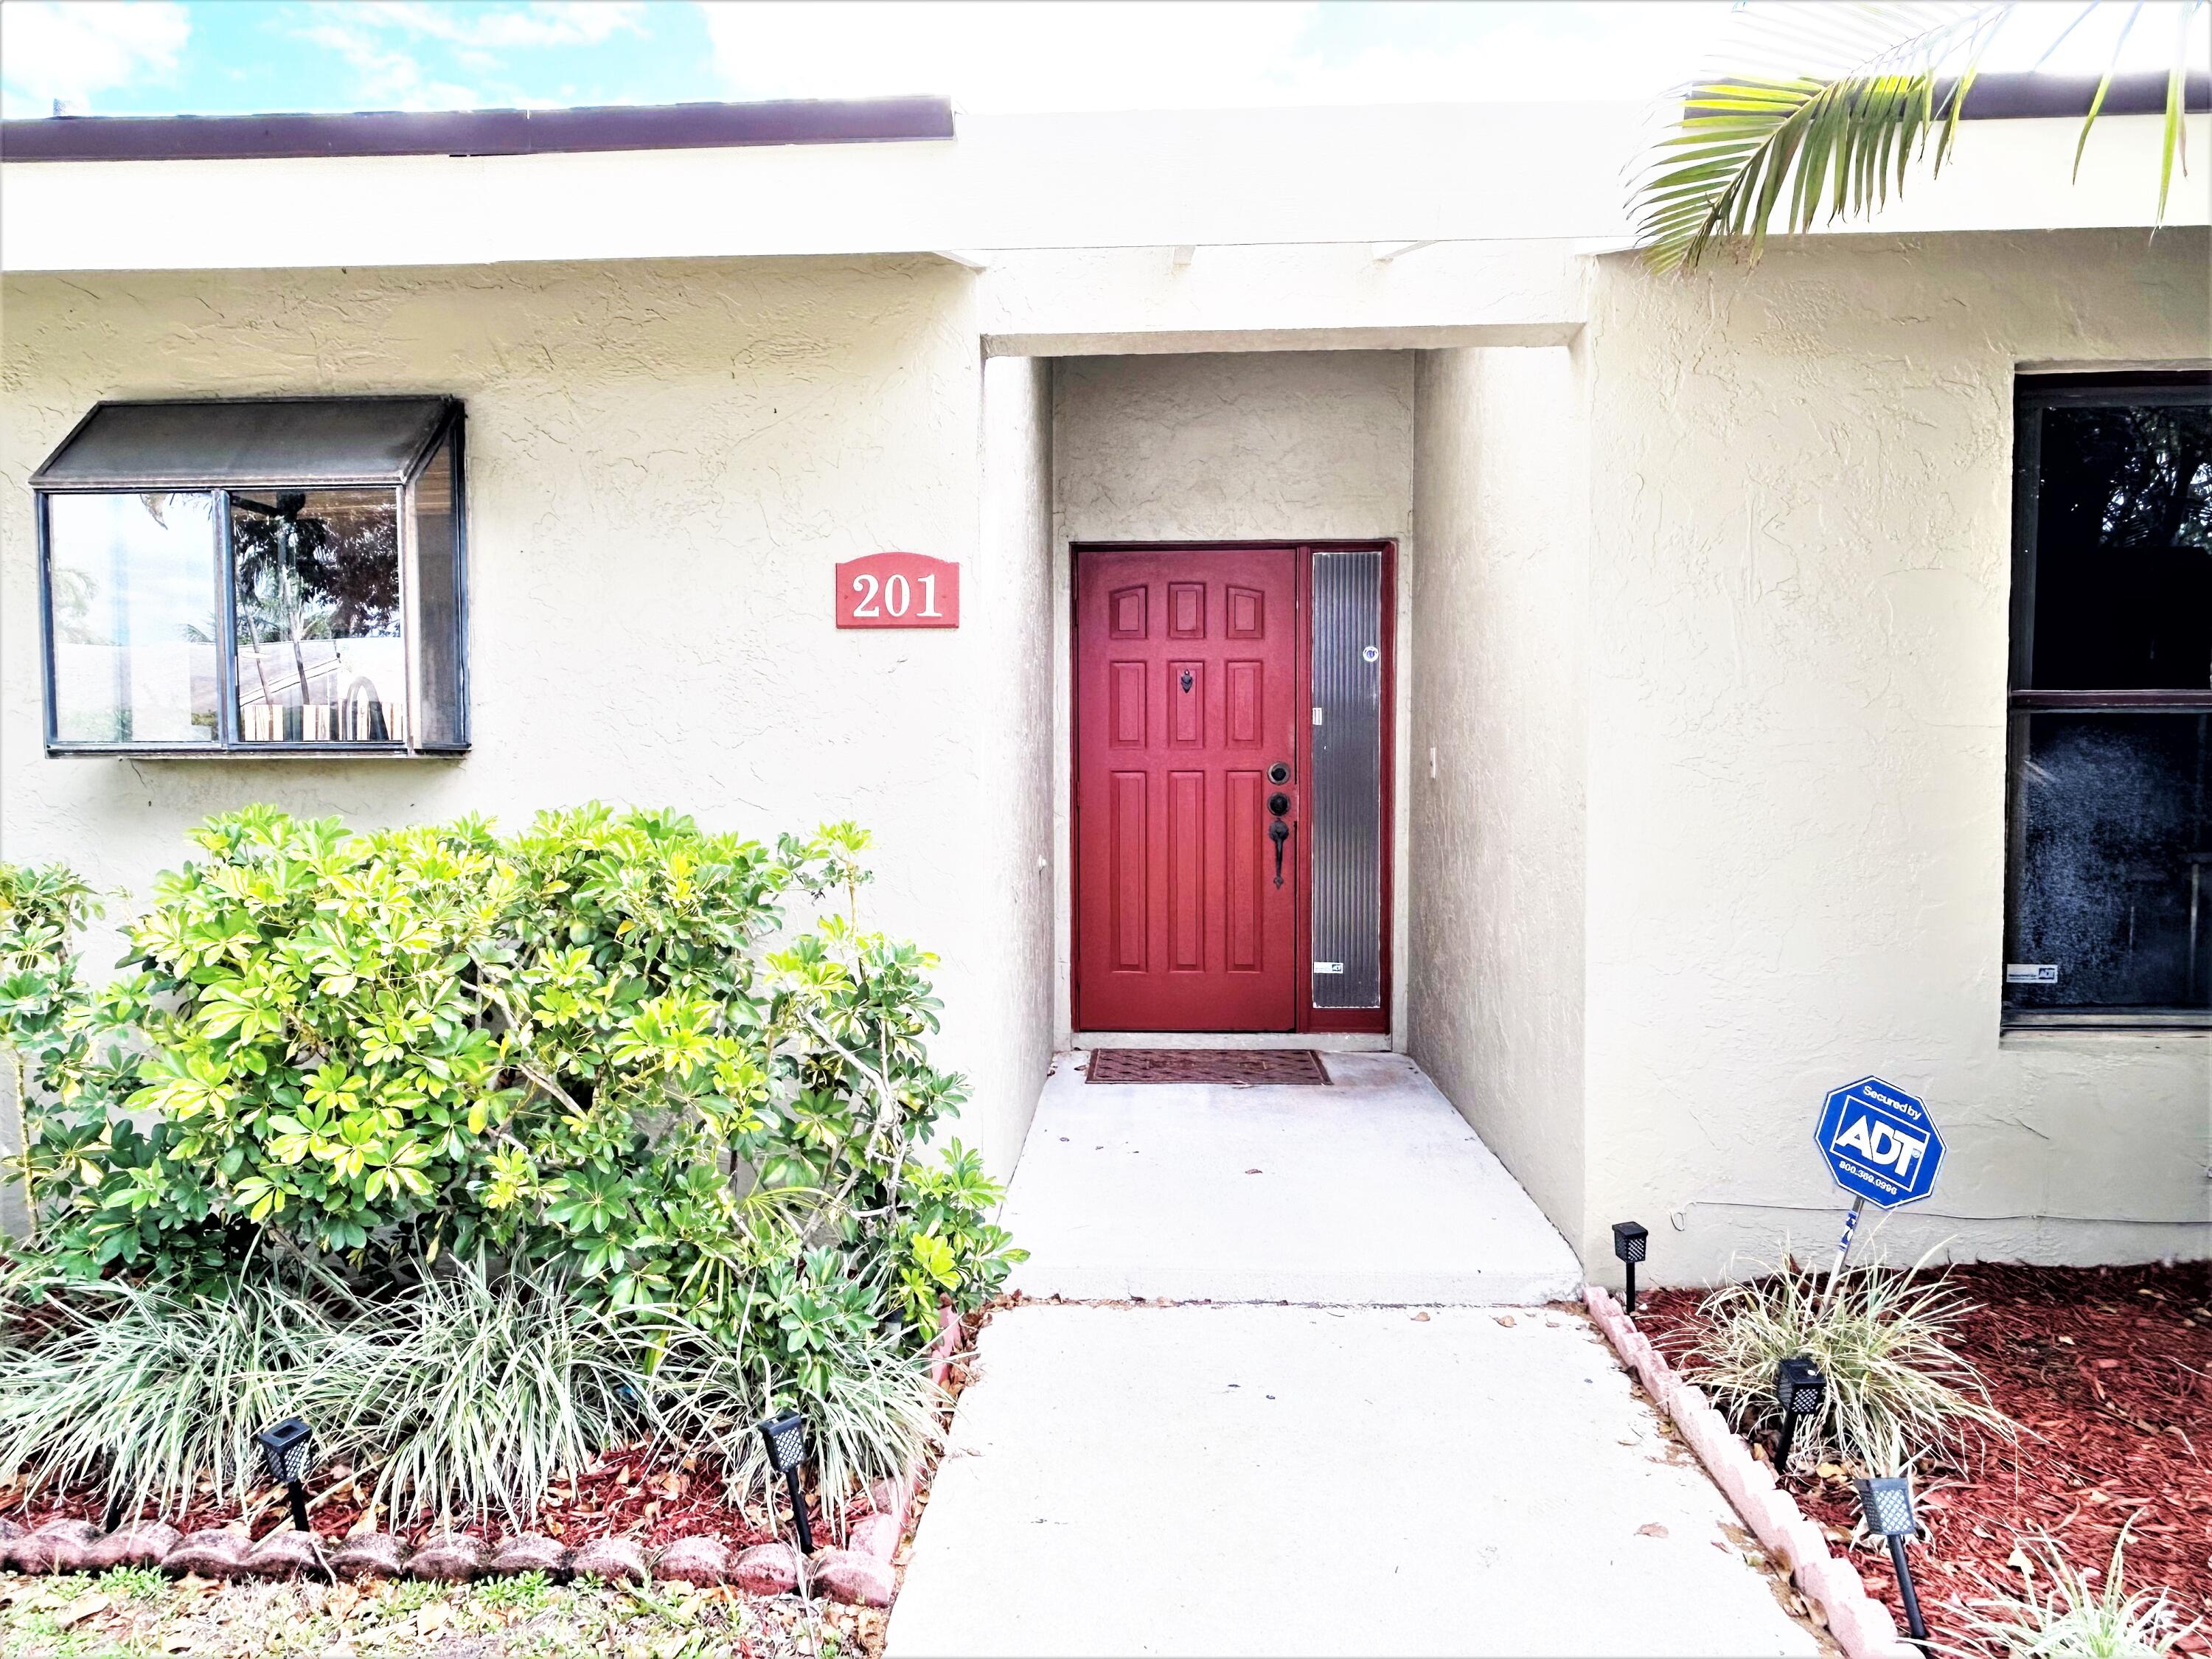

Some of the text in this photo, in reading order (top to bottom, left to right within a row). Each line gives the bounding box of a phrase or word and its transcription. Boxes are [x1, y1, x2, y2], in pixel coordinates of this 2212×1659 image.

[852, 574, 942, 617] 201
[1863, 1085, 1921, 1120] Secured by
[1835, 1115, 1925, 1177] ADT
